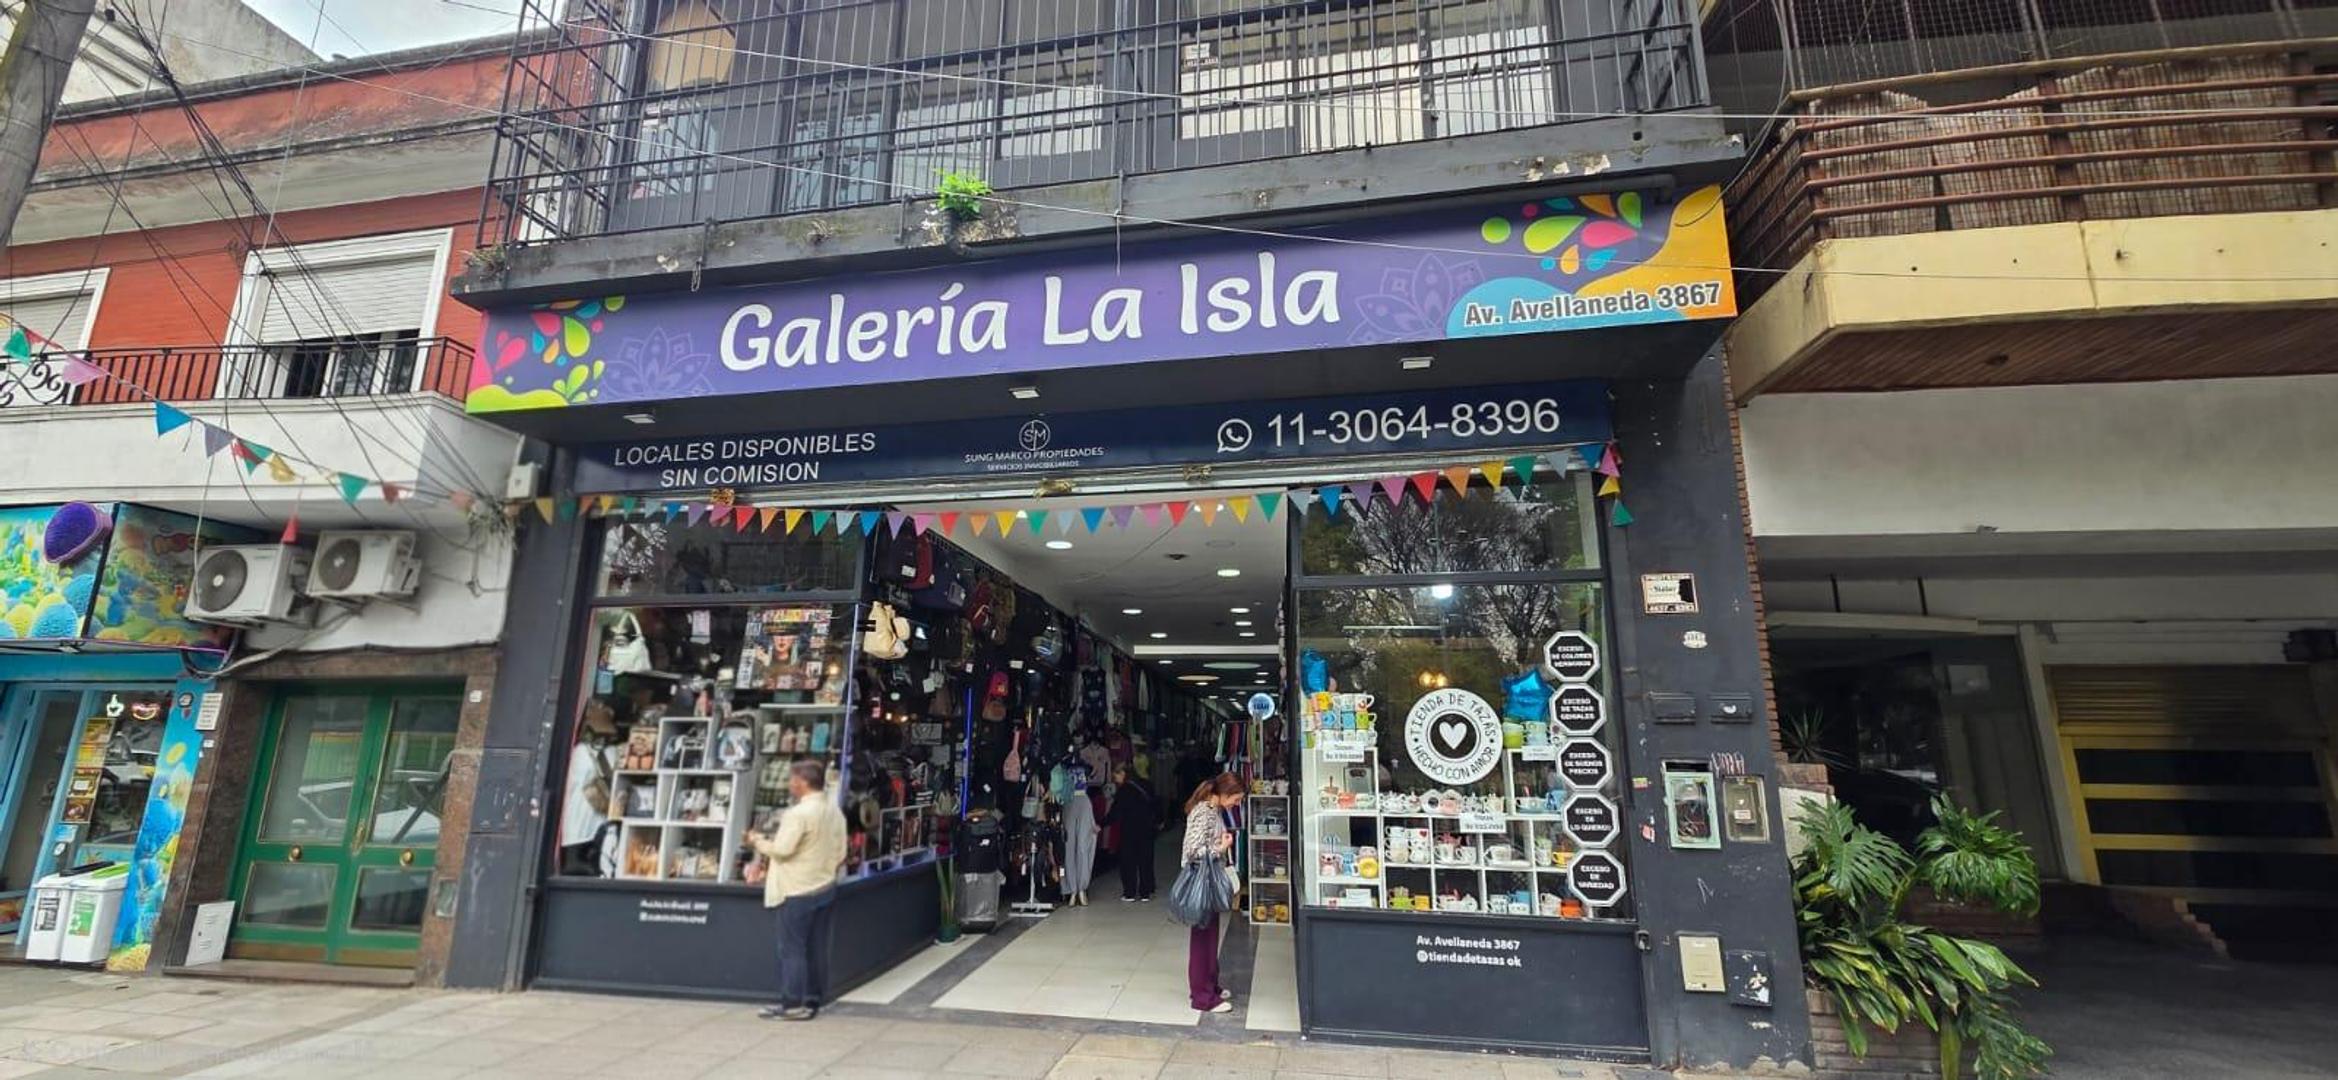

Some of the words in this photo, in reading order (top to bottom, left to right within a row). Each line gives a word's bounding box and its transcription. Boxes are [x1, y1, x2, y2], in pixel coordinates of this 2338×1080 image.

[720, 283, 1009, 372] Galería
[1043, 275, 1143, 346] La
[1180, 251, 1341, 335] Isla
[1465, 303, 1502, 326] Av.
[1510, 290, 1649, 322] Avellaneda
[1658, 282, 1721, 309] 3867
[1267, 398, 1561, 448] 11-3064-8396
[614, 441, 715, 466] LOCALES
[721, 432, 877, 460] DISPONIBLES
[964, 454, 993, 463] SUNG
[995, 451, 1032, 461] MARCO
[1033, 447, 1105, 459] PROPIEDADES
[660, 468, 699, 488] SIN
[704, 461, 820, 486] COMISION
[1410, 695, 1444, 736] TIENDA
[1448, 692, 1466, 706] DE
[1470, 700, 1496, 737] TAZAS
[1413, 744, 1445, 776] HECHO
[1445, 767, 1470, 780] CON
[1470, 746, 1494, 774] AMOR
[1417, 935, 1433, 946] Av.
[1434, 936, 1492, 949] Avellaneda
[1494, 939, 1520, 950] 3867
